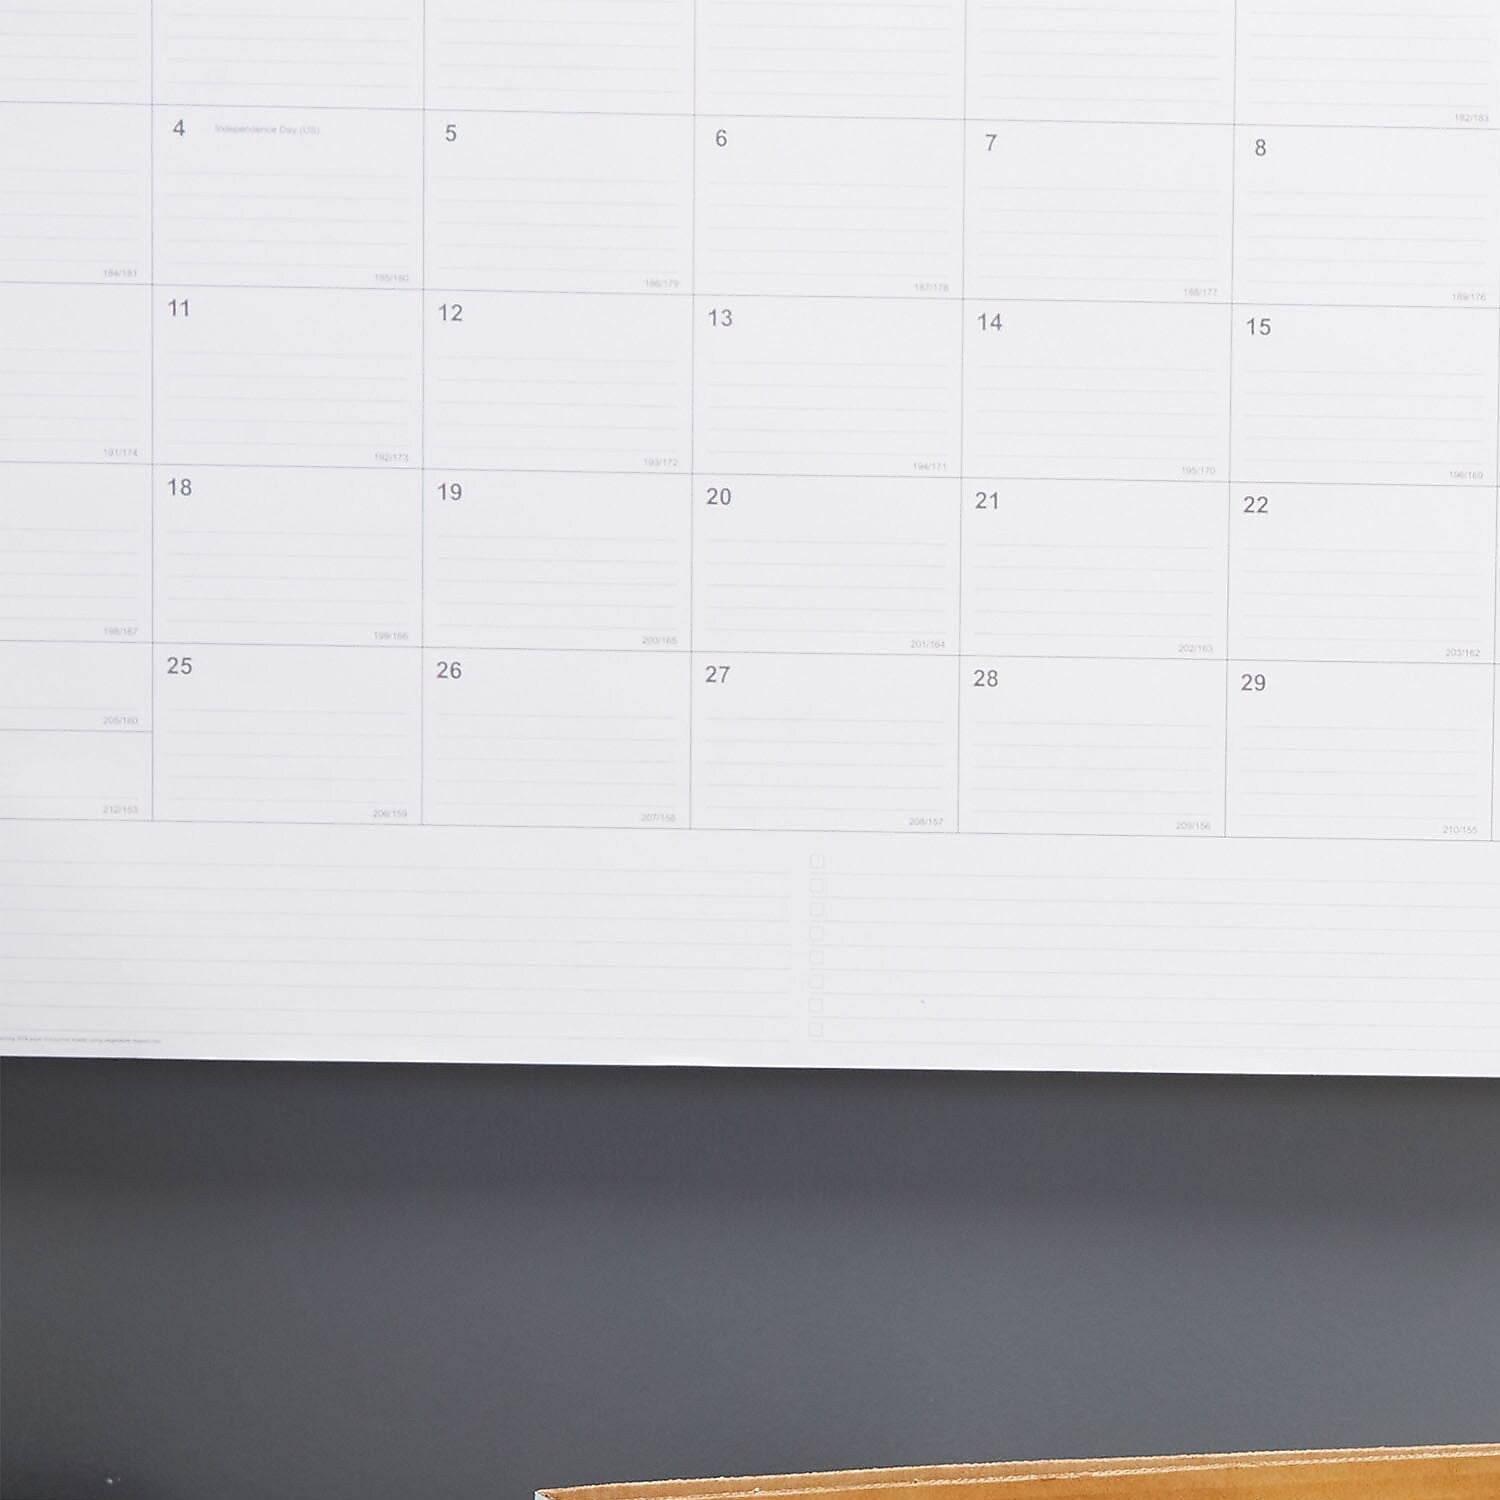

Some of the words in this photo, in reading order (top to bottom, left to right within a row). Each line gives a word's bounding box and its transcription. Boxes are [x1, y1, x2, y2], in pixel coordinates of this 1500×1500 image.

[172, 119, 186, 136] 4
[445, 124, 457, 142] 5
[715, 130, 728, 147] 6
[985, 134, 998, 151] 7
[1254, 139, 1267, 156] 8
[168, 299, 190, 316] 11
[438, 304, 463, 321] 12
[708, 309, 733, 326] 13
[978, 313, 1003, 330] 14
[1246, 318, 1272, 335] 15
[168, 478, 193, 496] 18
[437, 483, 463, 500] 19
[706, 488, 732, 505] 20
[975, 491, 999, 509] 21
[1243, 496, 1269, 513] 22
[167, 657, 193, 674] 25
[436, 661, 462, 679] 26
[705, 666, 731, 683] 27
[973, 670, 999, 687] 28
[1240, 674, 1267, 691] 29
